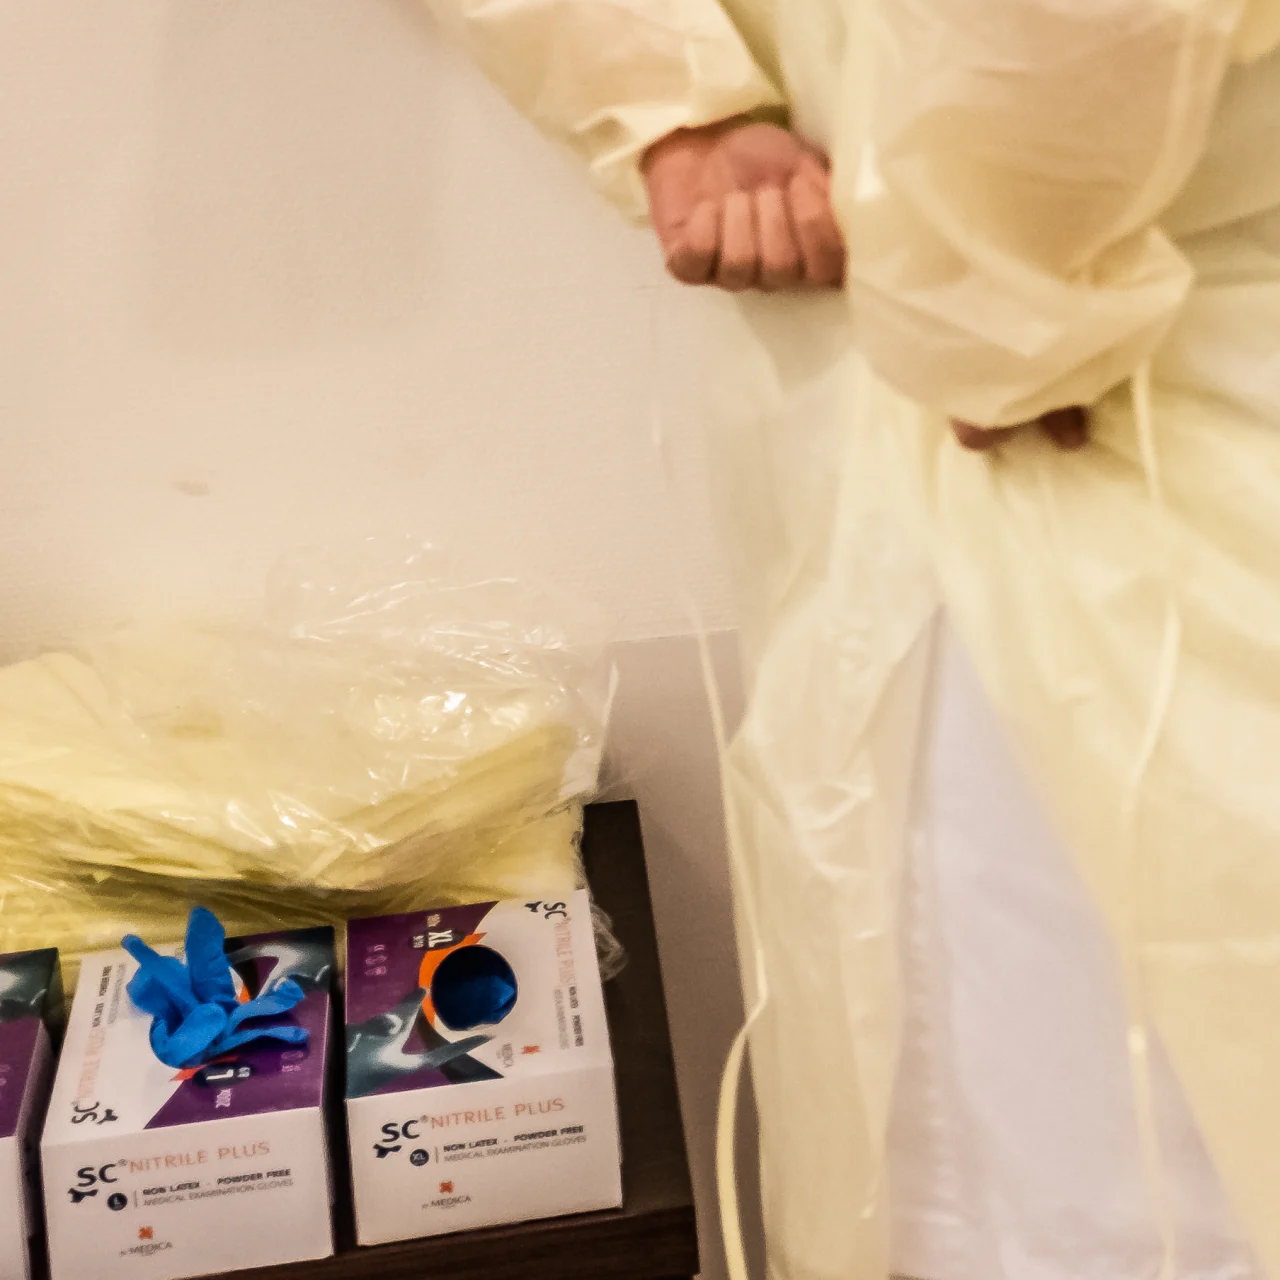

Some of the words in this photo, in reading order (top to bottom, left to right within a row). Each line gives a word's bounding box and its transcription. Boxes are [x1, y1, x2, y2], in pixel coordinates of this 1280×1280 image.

[428, 929, 453, 947] XL
[431, 1106, 506, 1129] NITRILE
[514, 1098, 566, 1117] PLUS
[443, 1142, 466, 1152] NON
[468, 1138, 498, 1148] LATEX
[513, 1129, 558, 1142] POWDER
[560, 1125, 584, 1135] FREE
[129, 1150, 209, 1173] NITRILE
[218, 1142, 271, 1161] PLUS
[169, 1181, 201, 1193] LATEX
[217, 1173, 263, 1186] POWDER
[266, 1168, 291, 1179] FREE
